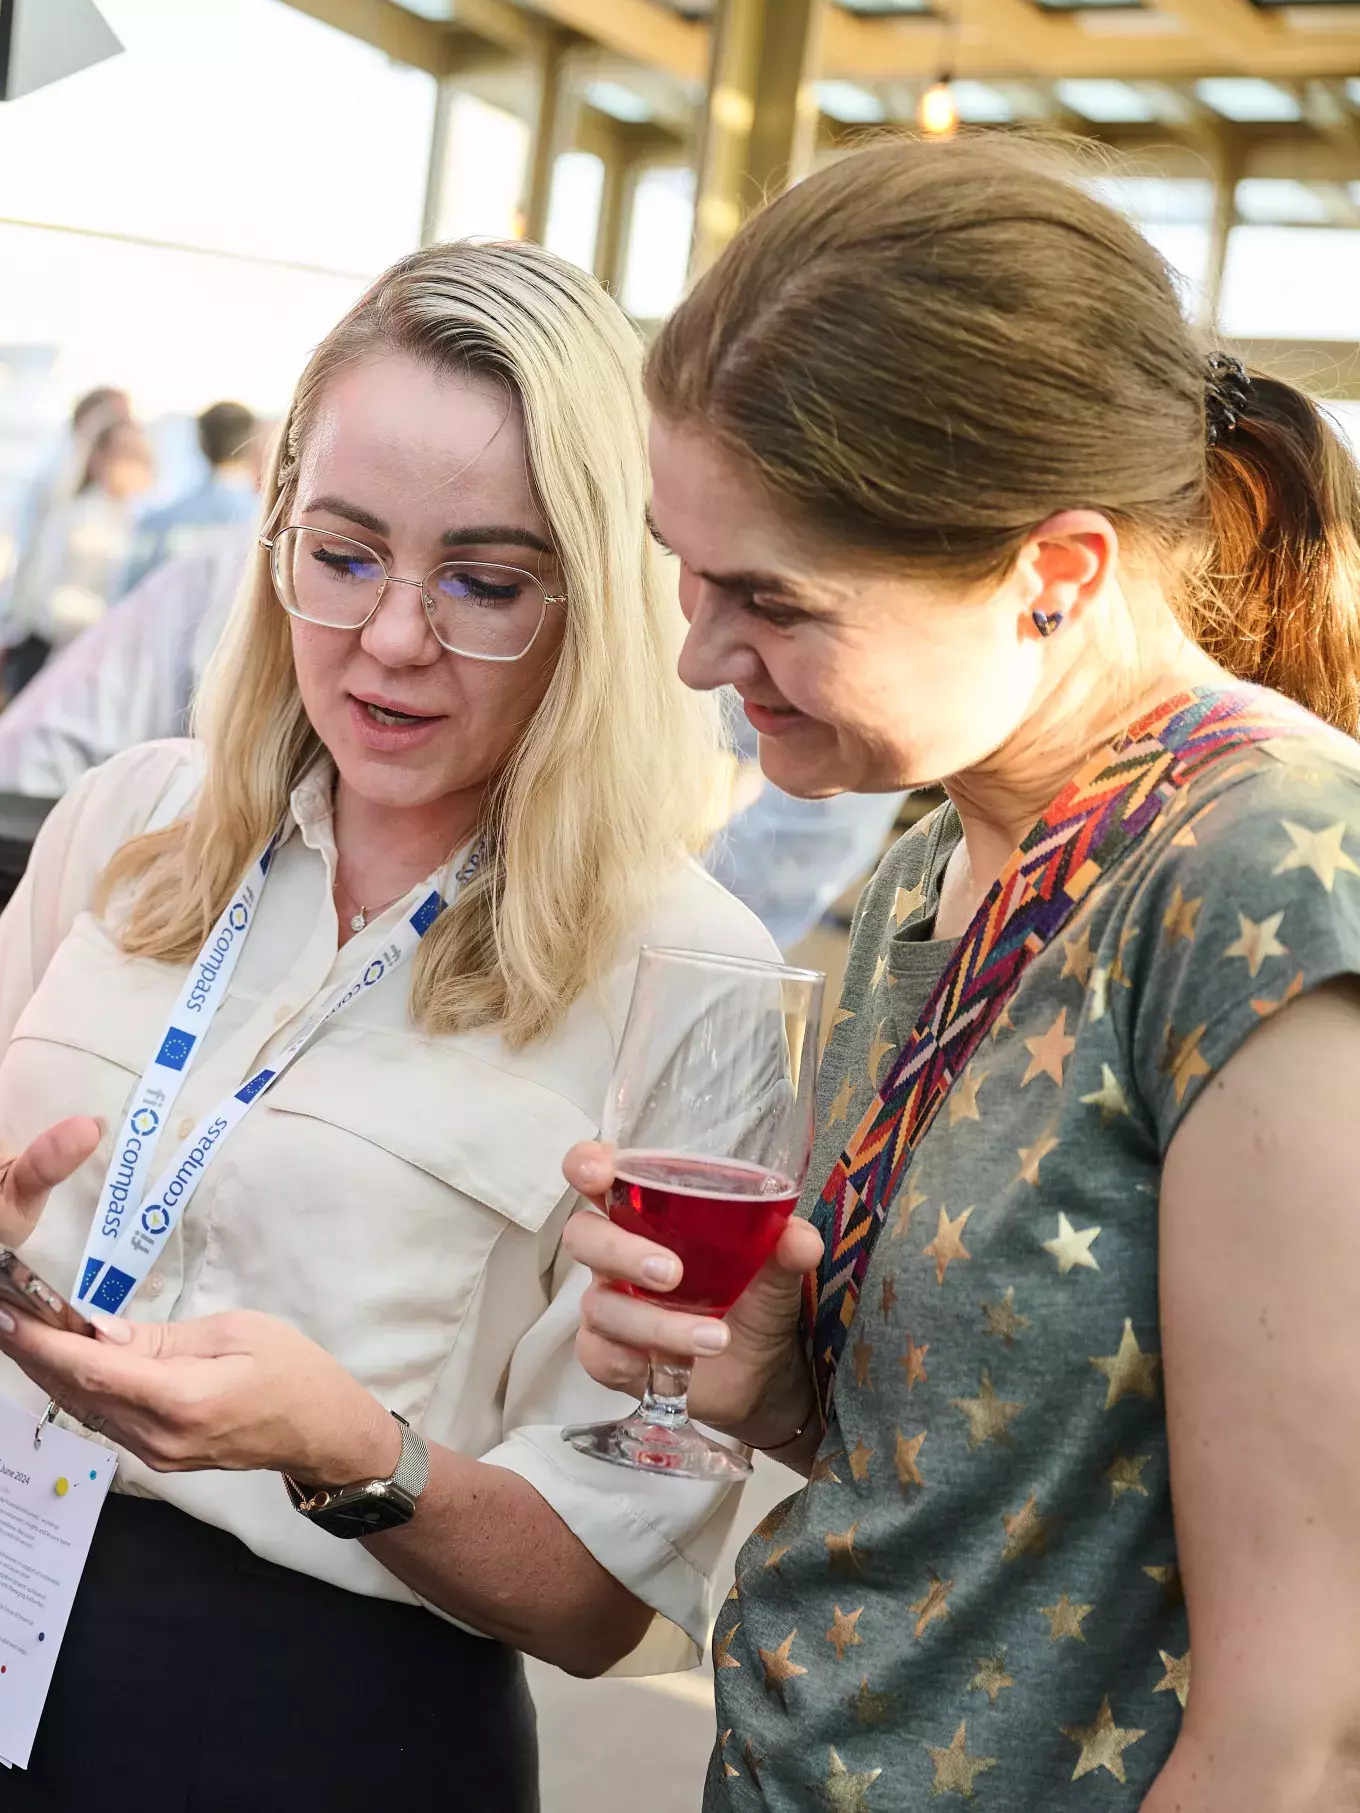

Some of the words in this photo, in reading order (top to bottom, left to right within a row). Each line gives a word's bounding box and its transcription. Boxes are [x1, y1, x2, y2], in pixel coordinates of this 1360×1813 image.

[187, 928, 233, 1012] compass
[142, 1088, 166, 1108] fi
[102, 1138, 142, 1238] compass
[131, 1230, 155, 1255] fi
[163, 1117, 228, 1207] compass
[0, 1464, 16, 1478] June
[14, 1470, 31, 1485] 2024
